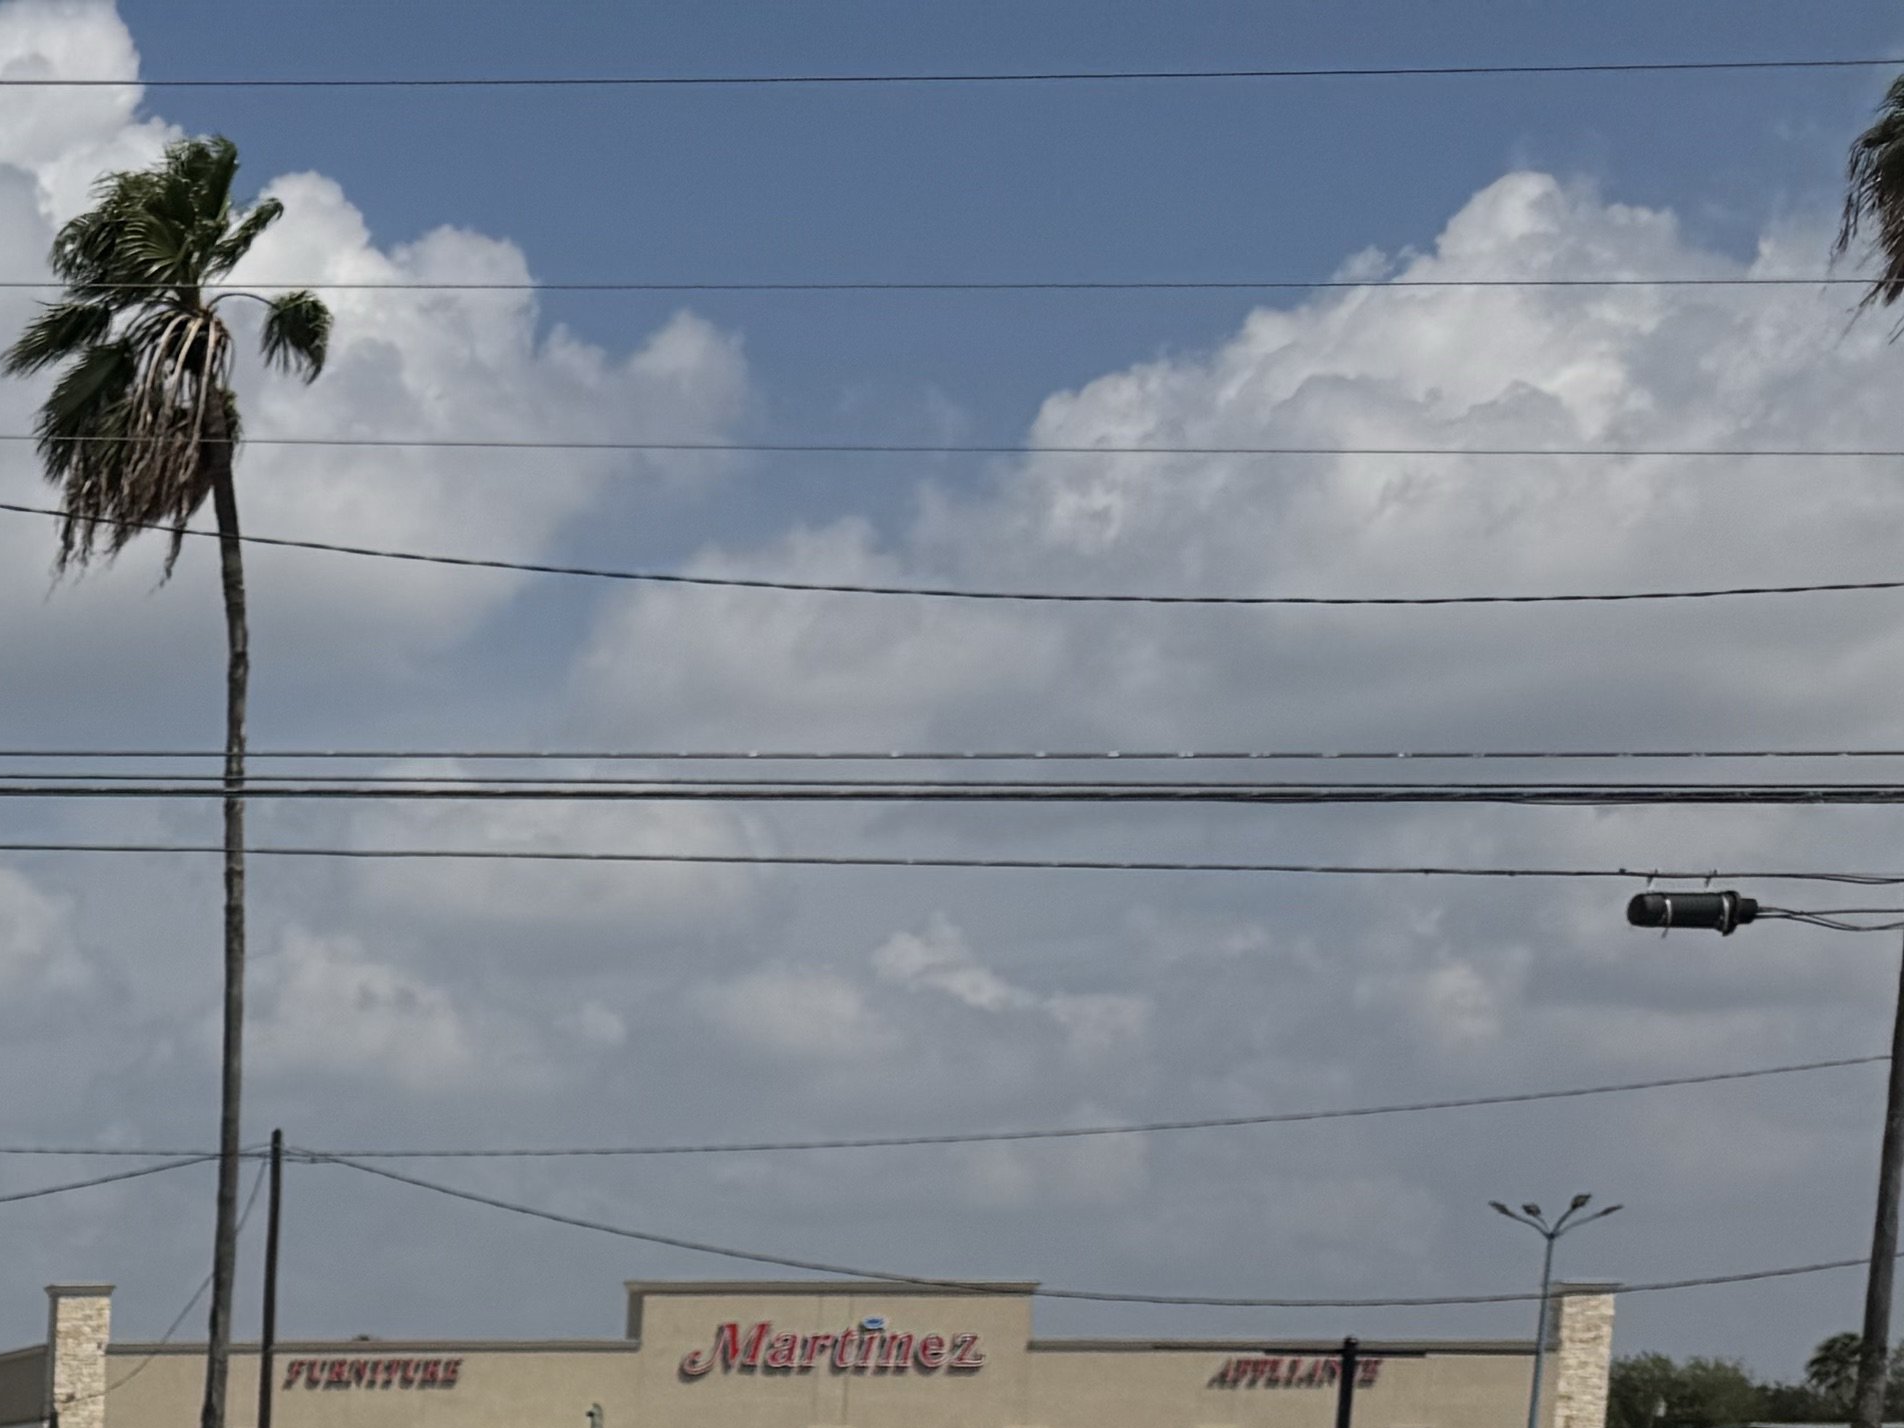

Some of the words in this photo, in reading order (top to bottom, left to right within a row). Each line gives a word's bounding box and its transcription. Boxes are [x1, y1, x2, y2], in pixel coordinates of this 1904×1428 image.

[680, 1318, 986, 1381] Martinez
[283, 1357, 463, 1388] FURNITURE
[1209, 1357, 1382, 1388] APPLIANE
